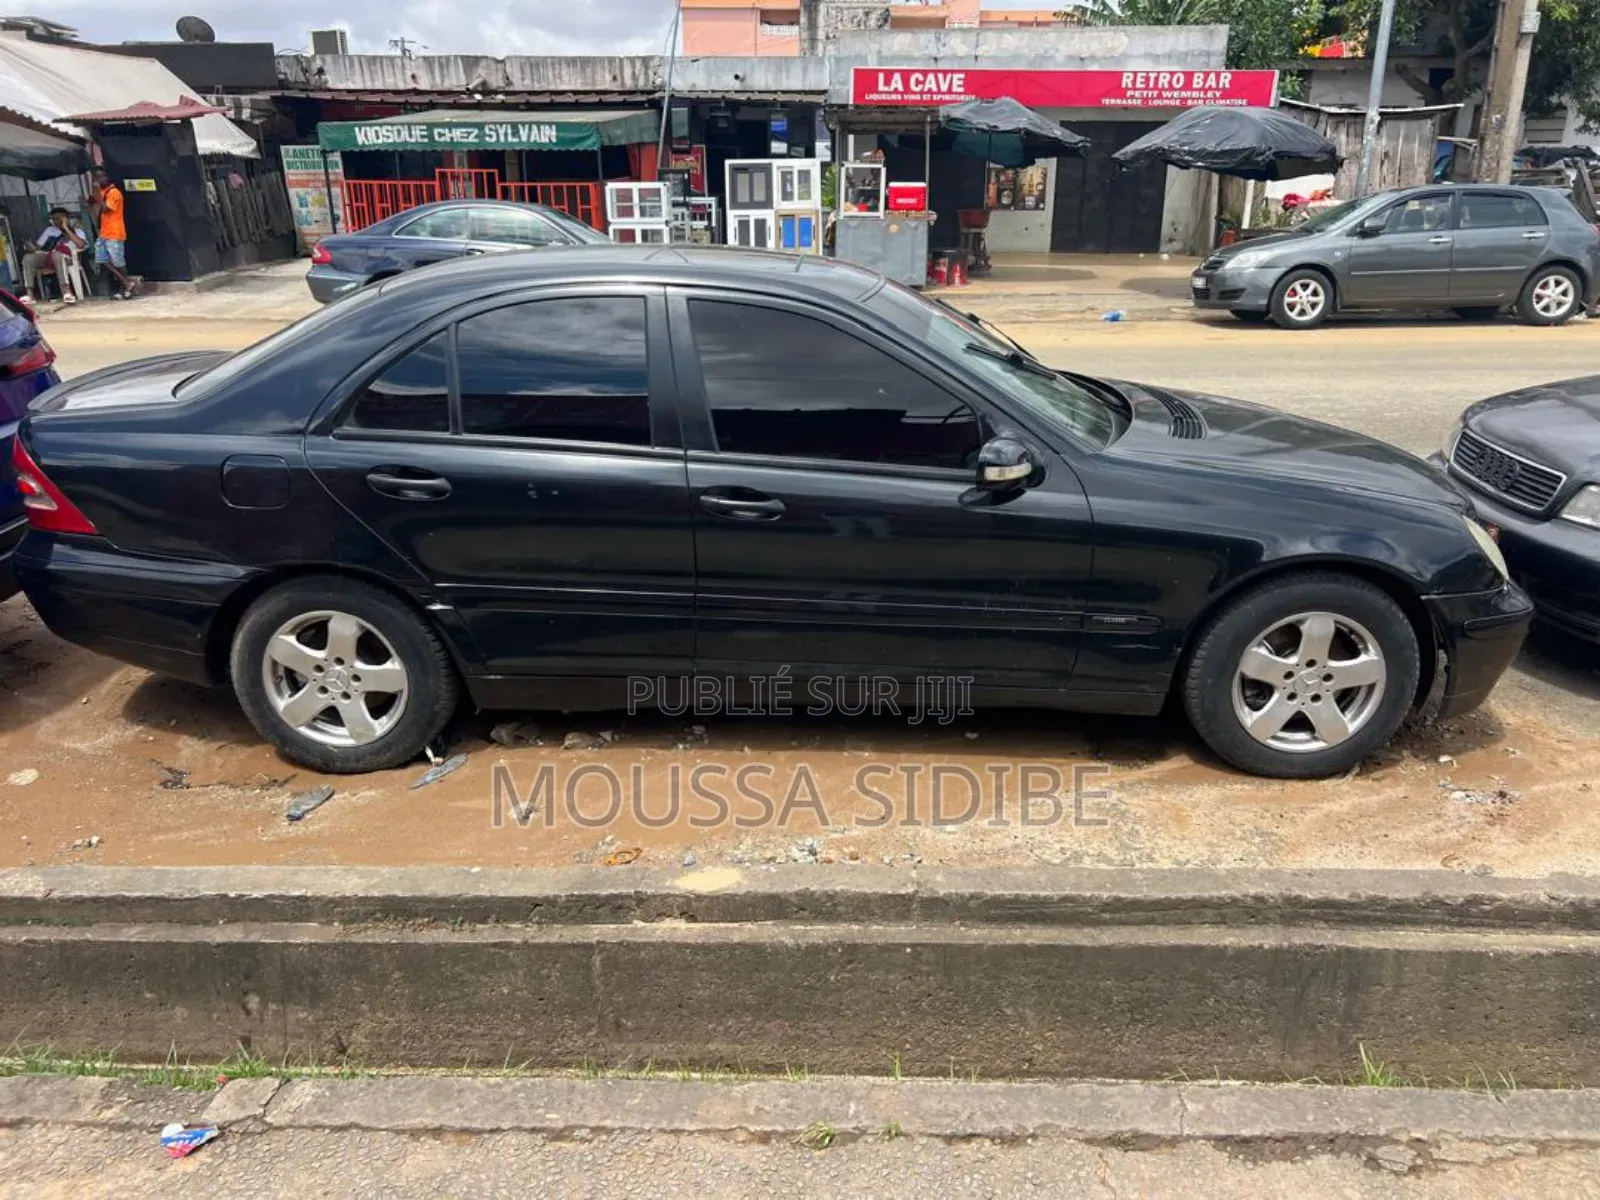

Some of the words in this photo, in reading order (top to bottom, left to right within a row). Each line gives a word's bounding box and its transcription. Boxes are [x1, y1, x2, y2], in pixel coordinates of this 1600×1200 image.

[878, 72, 904, 92] LA
[909, 72, 965, 92] CAVE
[1121, 72, 1185, 89] RETRO
[1192, 72, 1232, 89] BAR
[865, 93, 902, 101] LIQUEURS
[1126, 90, 1160, 98] PETIT
[1162, 90, 1222, 98] WEMBLEY
[1101, 98, 1143, 106] TERRASSE
[1149, 98, 1181, 106] LOUNGE
[1187, 98, 1205, 106] BAR
[433, 128, 479, 143] CHEZ
[484, 124, 557, 144] SYLVAIN
